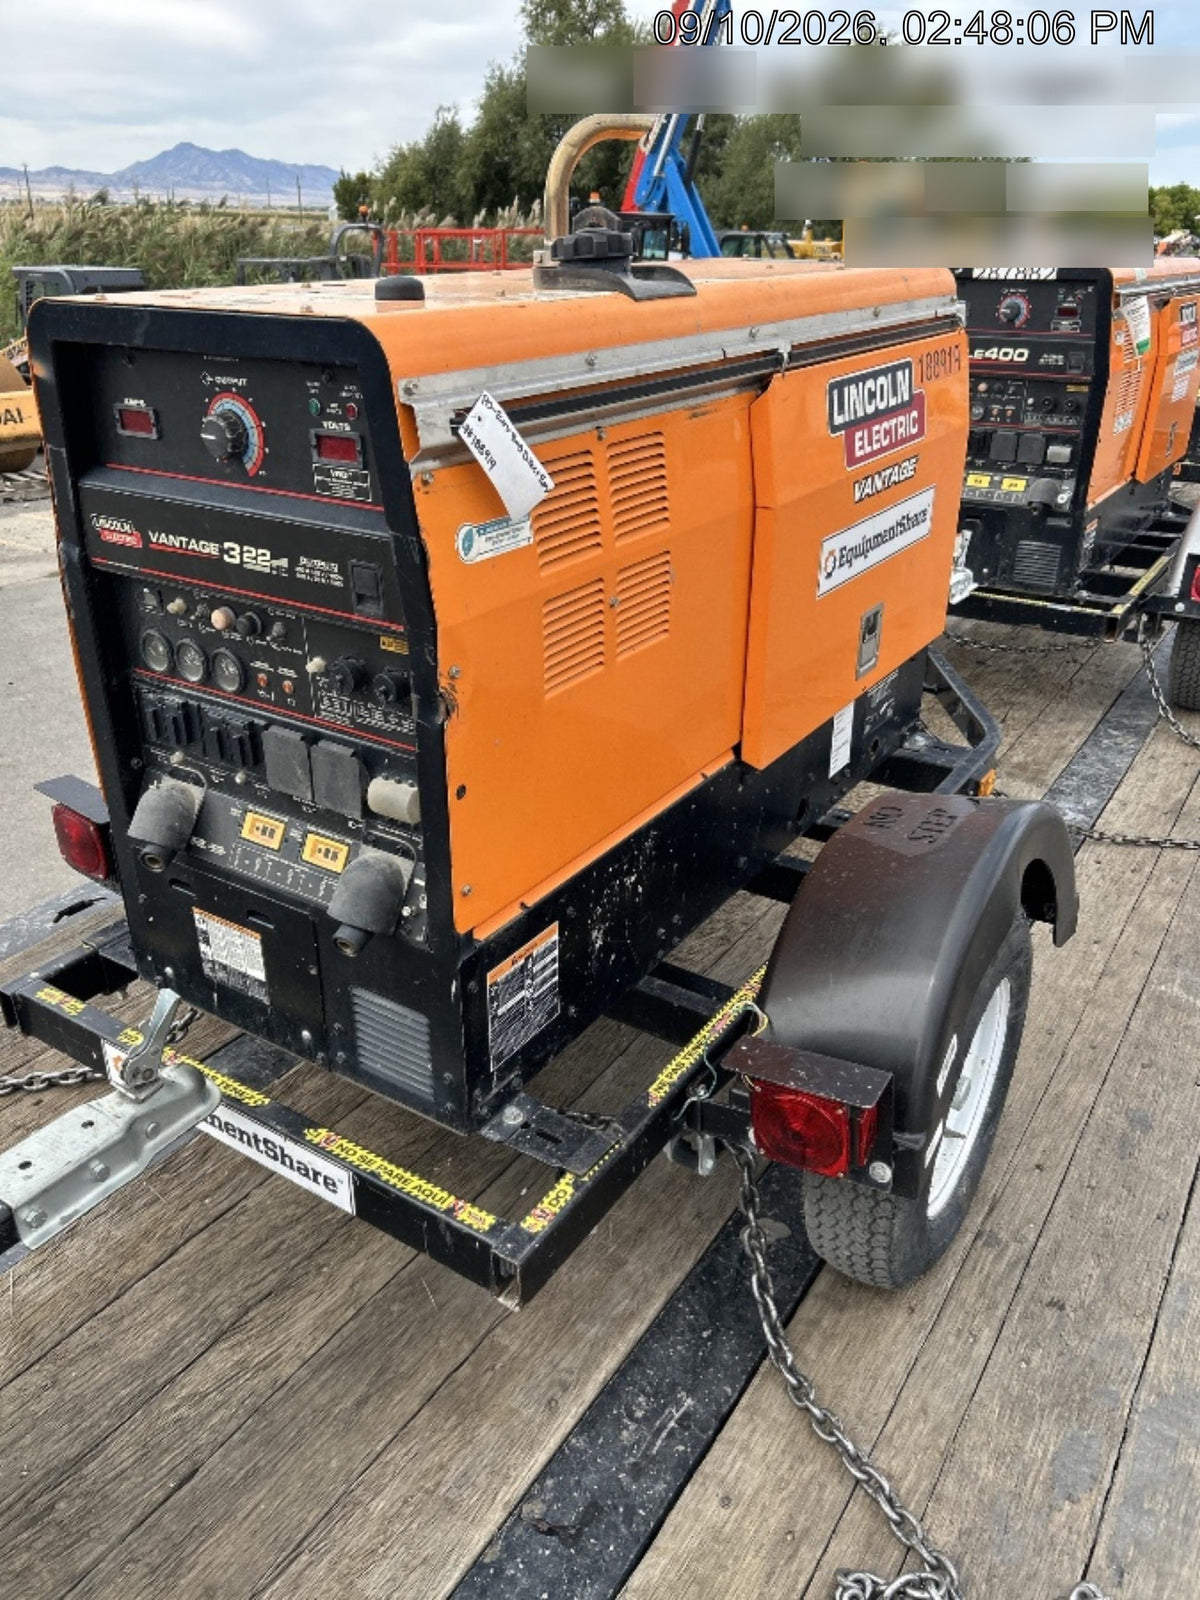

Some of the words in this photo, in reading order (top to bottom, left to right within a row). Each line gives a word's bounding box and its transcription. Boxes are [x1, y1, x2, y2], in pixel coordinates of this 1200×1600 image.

[0, 407, 24, 425] AI
[833, 368, 910, 425] LINCOLN
[855, 410, 918, 457] ELECTRIC
[854, 456, 919, 503] VANTAGE
[149, 531, 220, 556] VANTAGE
[223, 541, 271, 567] 322
[838, 508, 929, 570] EquipmentShare
[336, 1142, 356, 1158] NO
[357, 1154, 377, 1170] SE
[377, 1164, 413, 1187] PARE
[413, 1183, 448, 1207] AQUI
